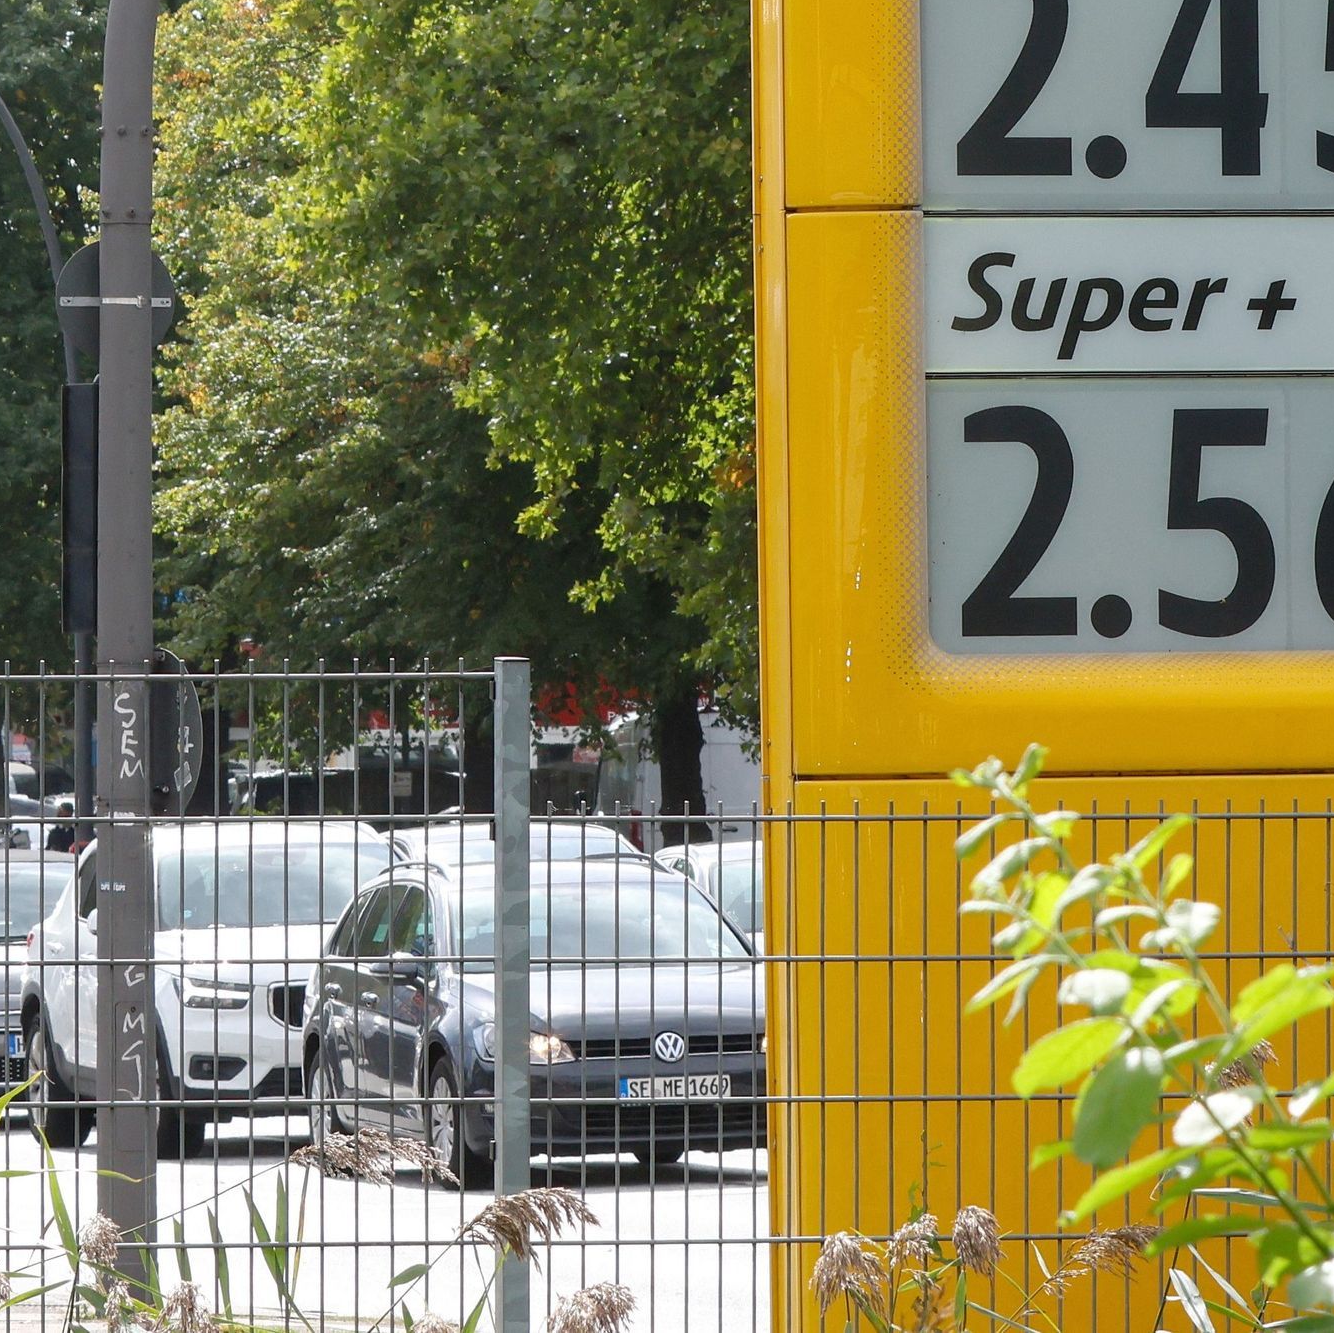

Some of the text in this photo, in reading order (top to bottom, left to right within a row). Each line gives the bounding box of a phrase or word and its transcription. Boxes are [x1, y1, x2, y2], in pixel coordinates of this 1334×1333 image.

[950, 251, 1229, 360] Super
[629, 1080, 649, 1098] SE
[663, 1079, 684, 1097] ME
